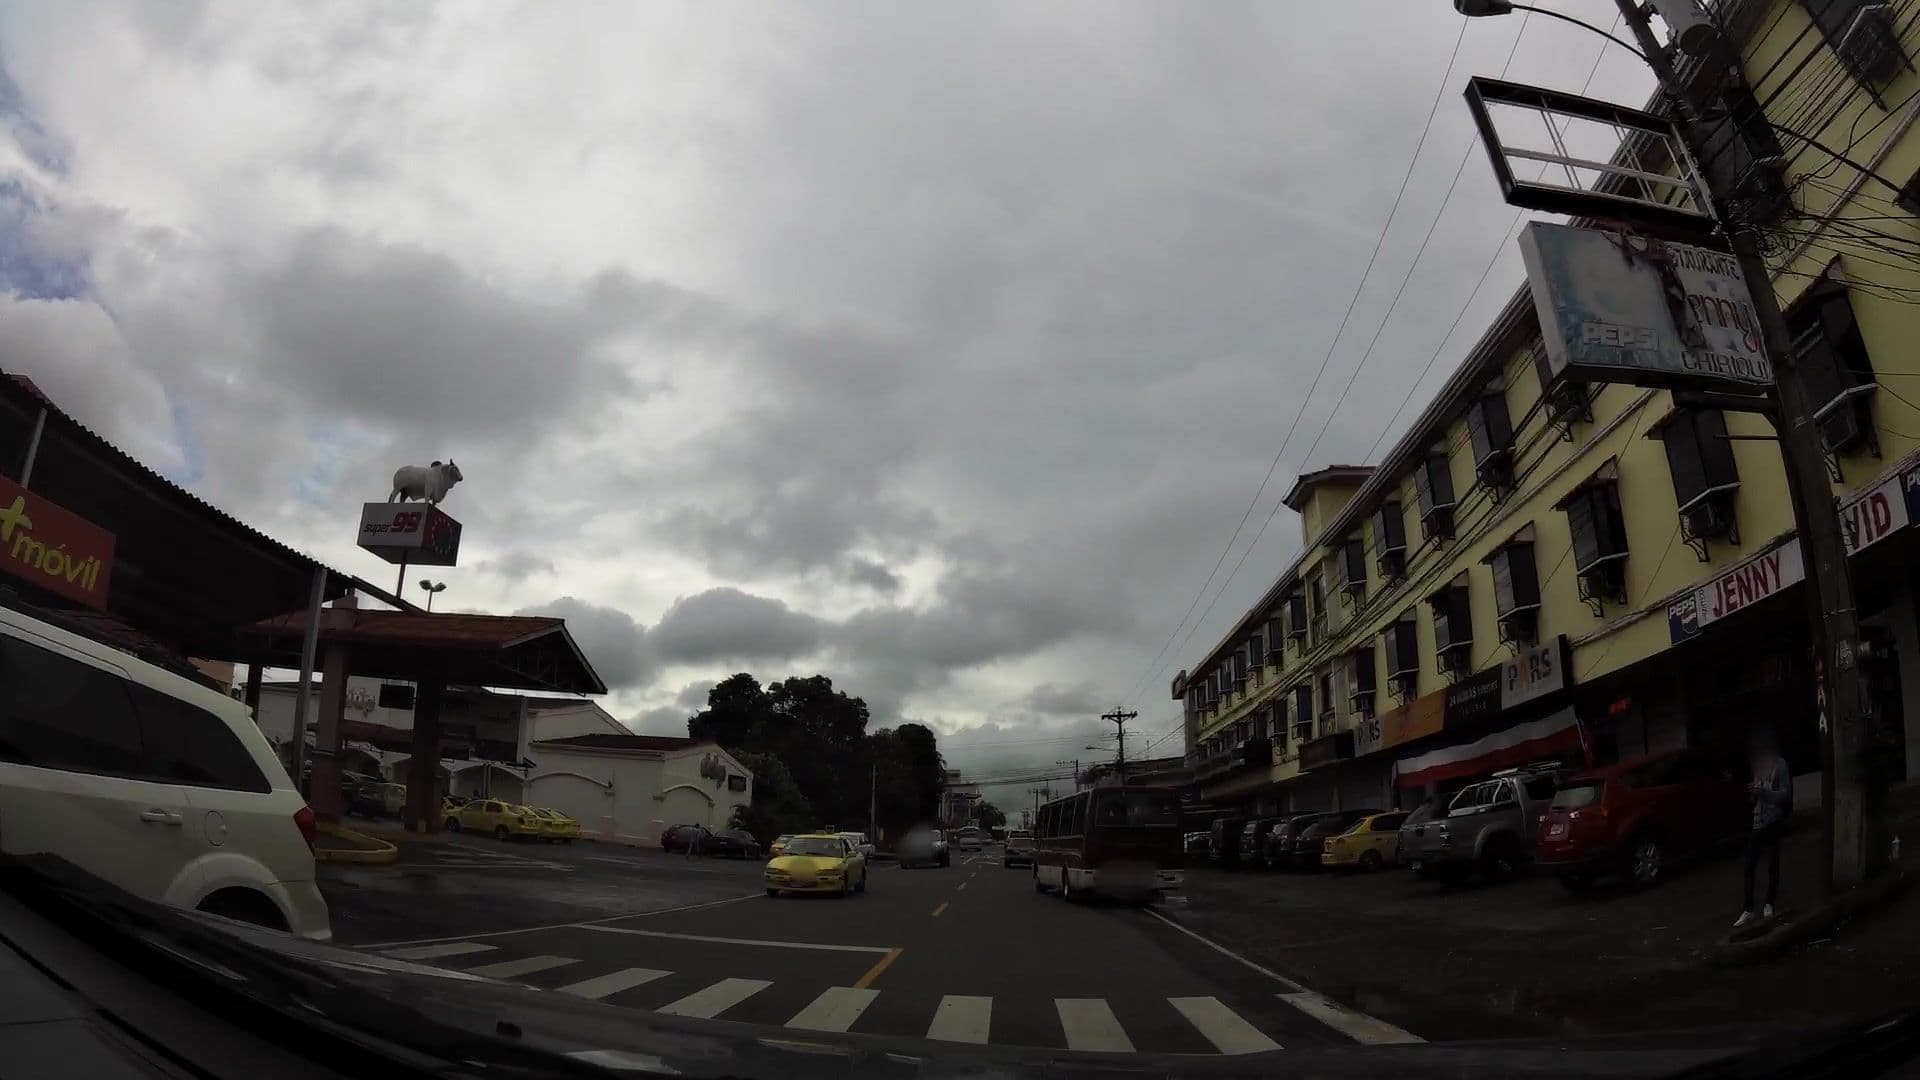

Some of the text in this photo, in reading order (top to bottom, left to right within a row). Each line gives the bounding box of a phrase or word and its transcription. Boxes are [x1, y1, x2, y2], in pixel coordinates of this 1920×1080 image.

[1583, 320, 1659, 352] PEPSI
[10, 532, 101, 592] móvil
[1712, 550, 1780, 617] JENNY
